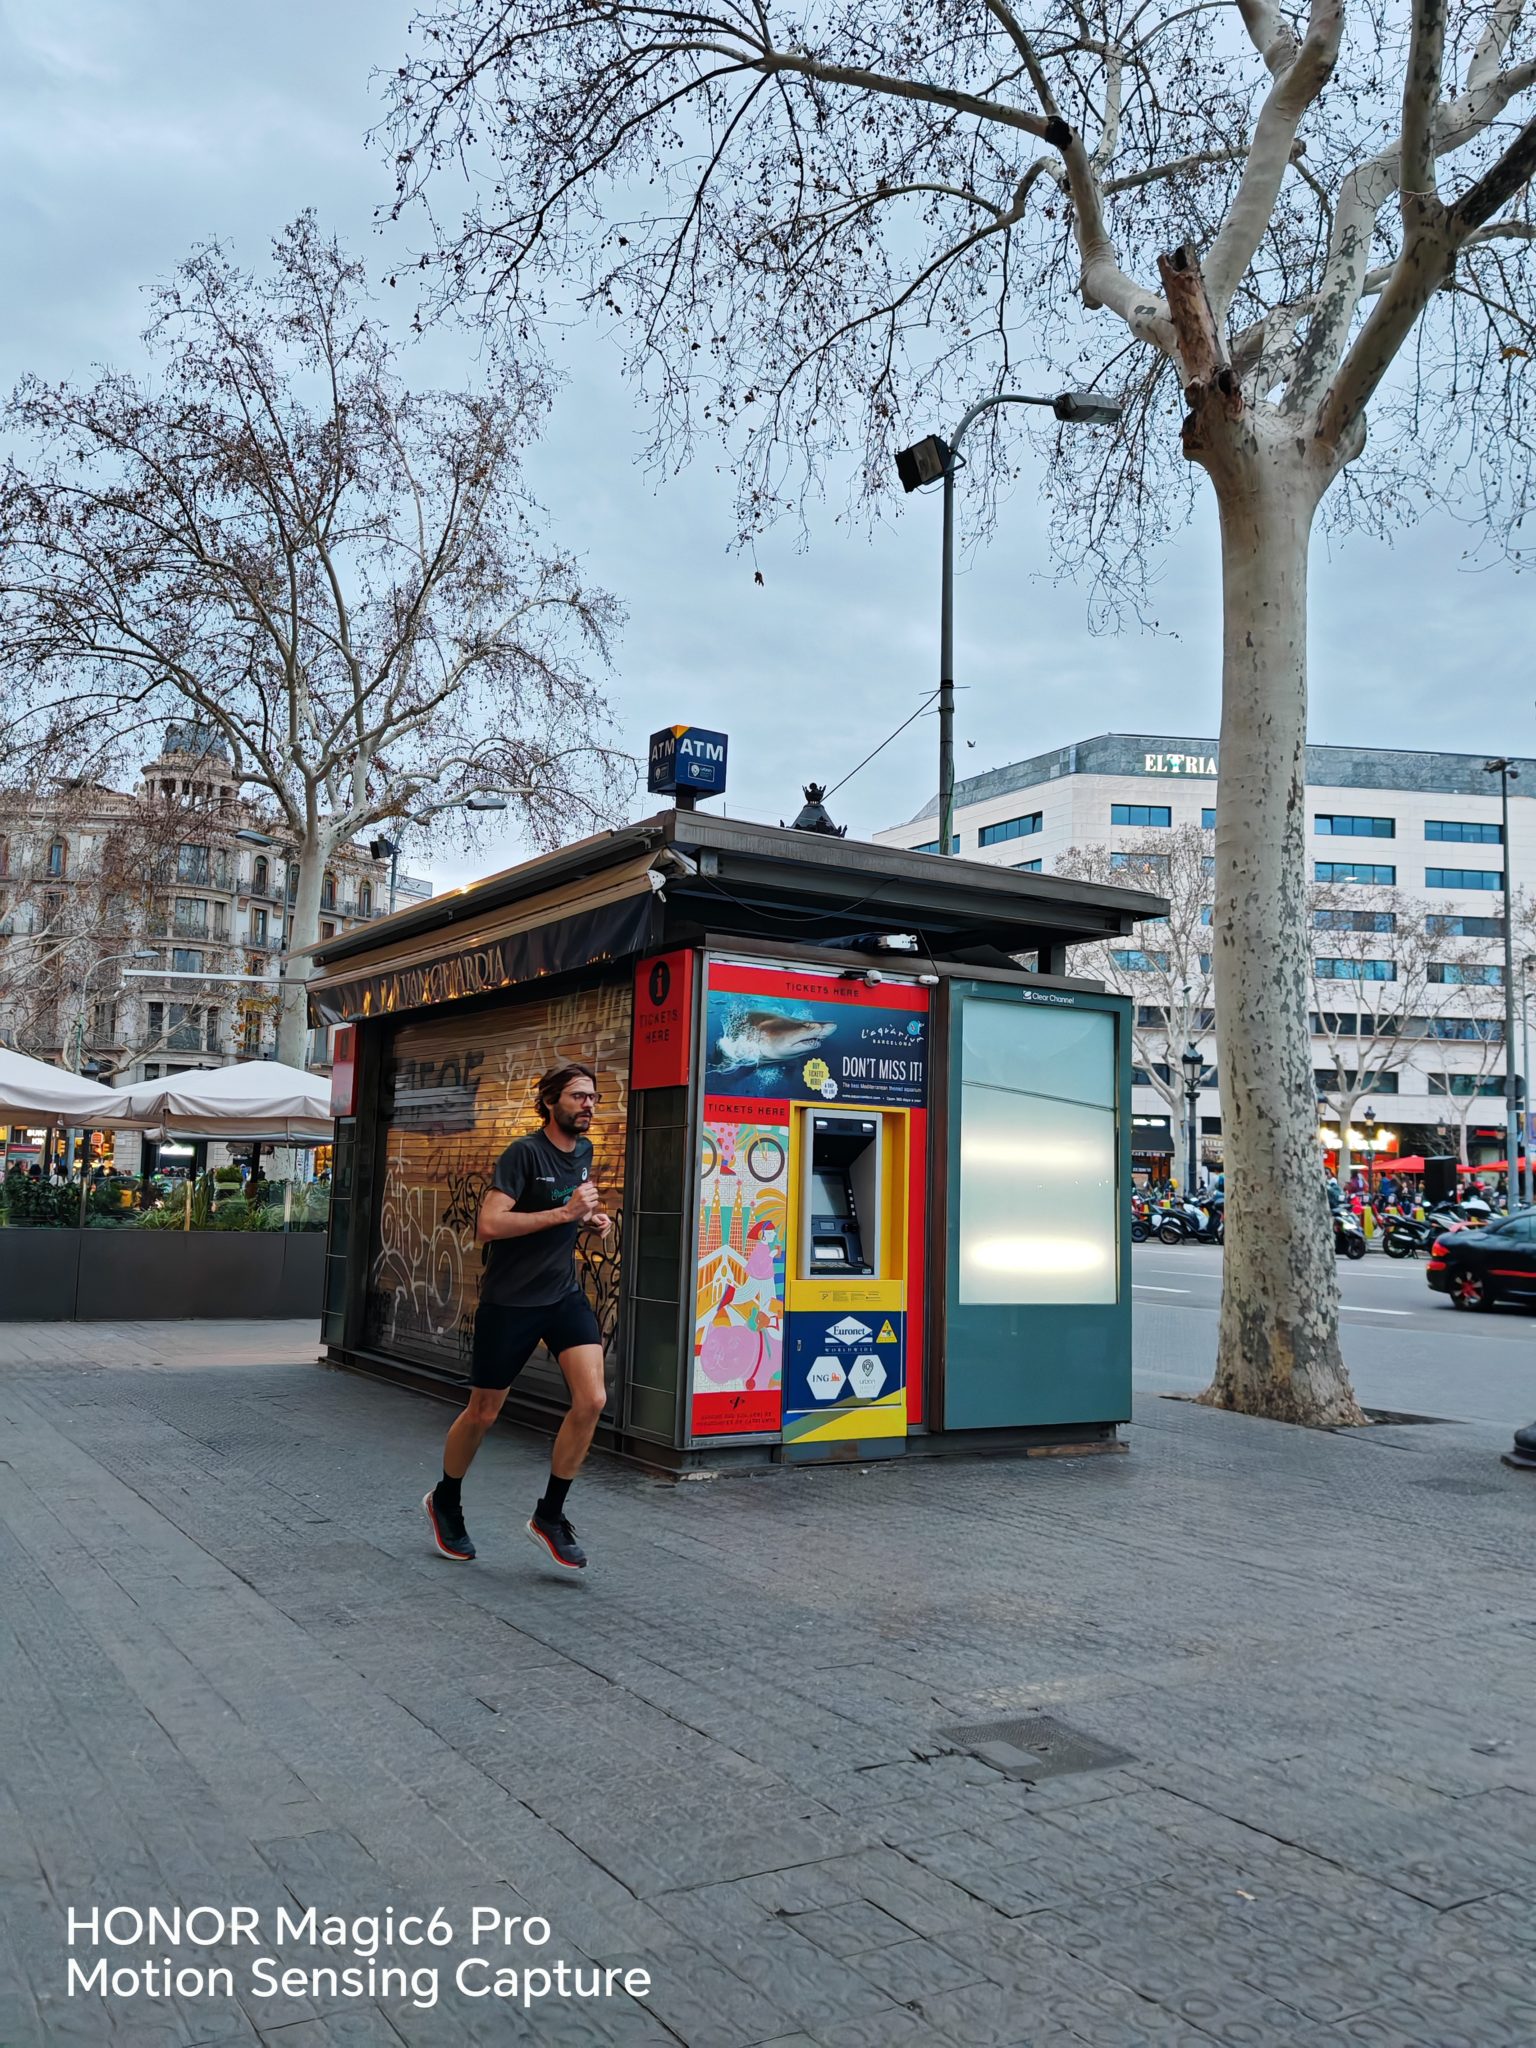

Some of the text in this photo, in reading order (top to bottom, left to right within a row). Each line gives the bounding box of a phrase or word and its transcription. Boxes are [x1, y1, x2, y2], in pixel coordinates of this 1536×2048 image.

[651, 738, 675, 762] ATM
[680, 738, 724, 762] ATM
[786, 982, 860, 997] TICKETS HERE
[1032, 992, 1075, 1004] Clear Channel
[639, 1009, 679, 1028] TICKETS
[645, 1029, 670, 1044] HERE
[872, 1039, 912, 1047] BARCELONA
[842, 1056, 923, 1082] DON'T MISS IT!
[708, 1103, 786, 1116] TICKETS HERE
[833, 1325, 866, 1336] Euronet
[812, 1374, 830, 1383] ING
